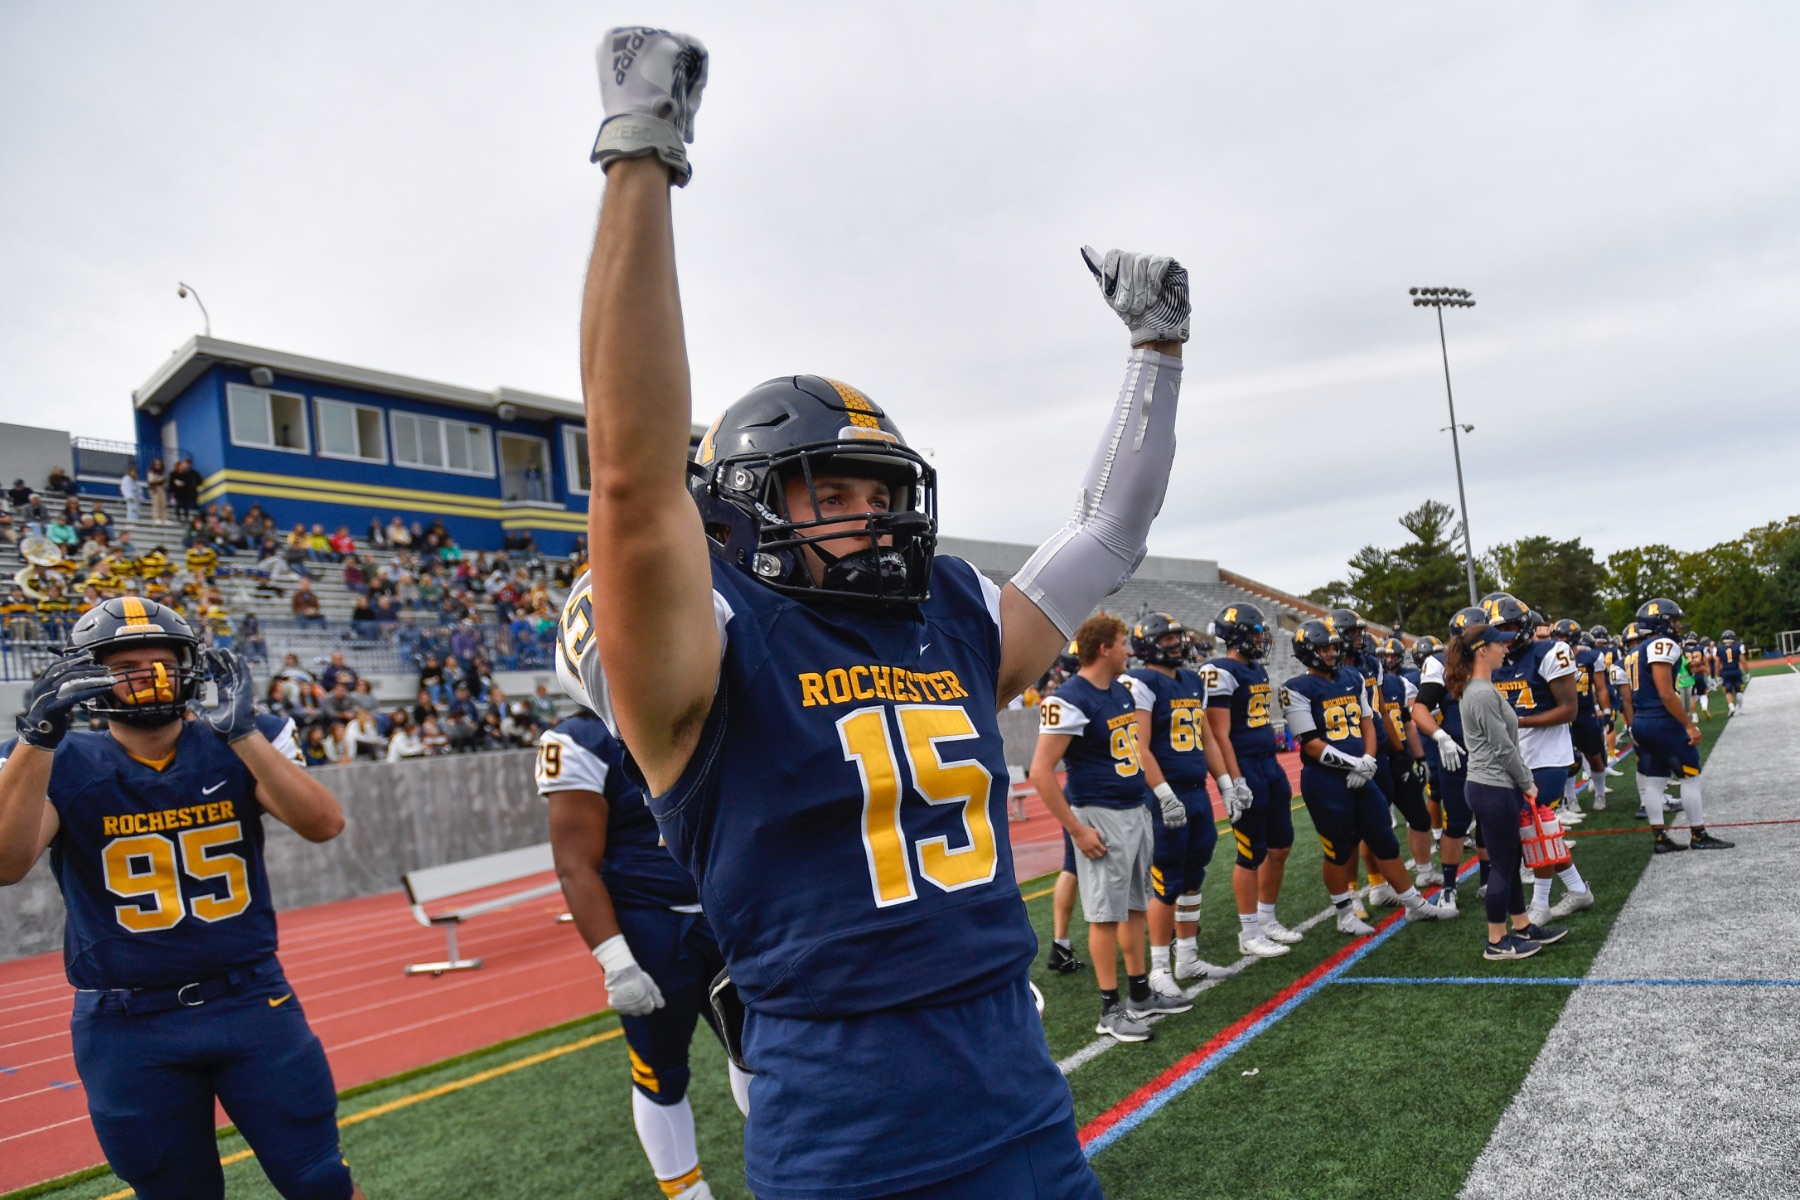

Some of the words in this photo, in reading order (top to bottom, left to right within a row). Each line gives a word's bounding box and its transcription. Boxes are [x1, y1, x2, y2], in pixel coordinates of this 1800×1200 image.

[1654, 641, 1674, 656] 97
[798, 665, 969, 707] ROCHESTER
[1322, 695, 1358, 710] ROCHESTER
[1494, 680, 1529, 692] CHESTER
[1041, 703, 1061, 726] 96
[1323, 702, 1363, 741] 93
[537, 742, 563, 779] 9
[103, 799, 236, 836] ROCHESTER
[835, 704, 998, 908] 15
[102, 820, 251, 934] 95
